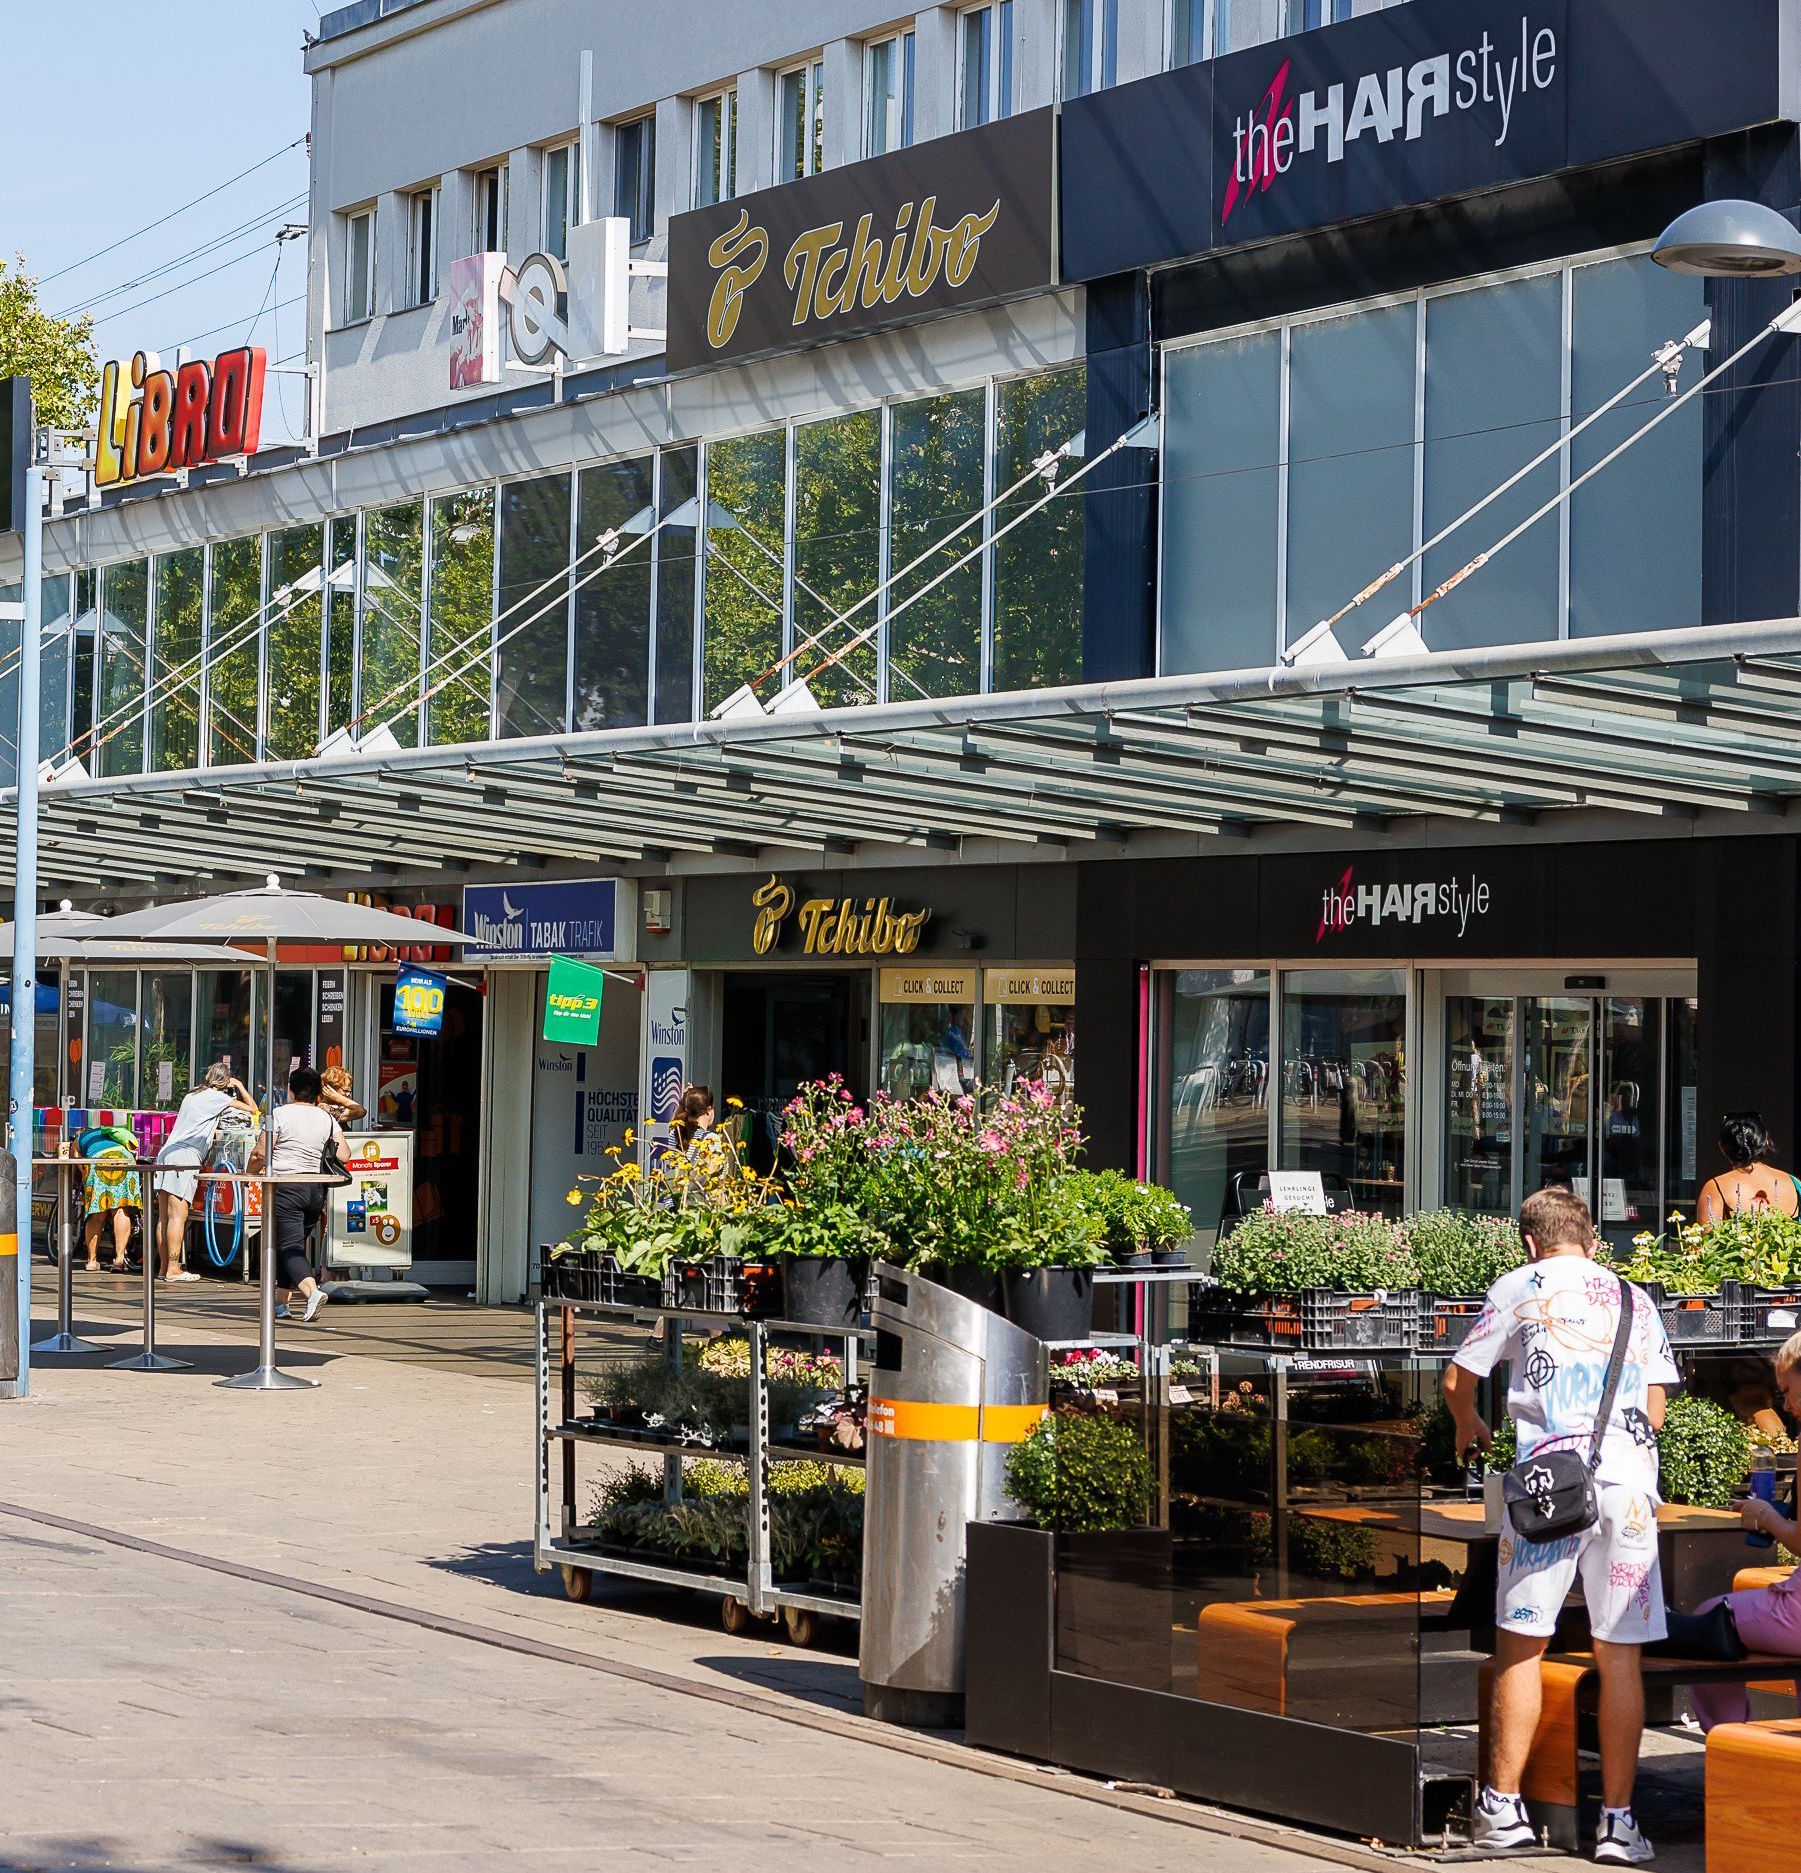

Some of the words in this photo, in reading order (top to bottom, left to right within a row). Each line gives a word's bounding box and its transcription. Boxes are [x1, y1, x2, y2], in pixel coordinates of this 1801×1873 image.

[785, 196, 1000, 327] Tchibo
[798, 897, 928, 954] Tchibo
[530, 922, 567, 949] TABAK
[569, 920, 603, 948] TRAFIK
[903, 979, 924, 994] CLICK
[925, 977, 932, 994] &
[933, 980, 964, 994] COLLECT
[1008, 979, 1031, 994] CLICK
[1032, 977, 1040, 995] &
[1041, 980, 1075, 995] COLLECT
[397, 985, 444, 1014] 100
[651, 1020, 685, 1045] Winston
[539, 1057, 573, 1071] Winston
[588, 1089, 638, 1106] HÖCHSTE
[588, 1106, 638, 1123] QUALITÄT
[586, 1124, 608, 1139] SEIT
[531, 1262, 541, 1270] 70
